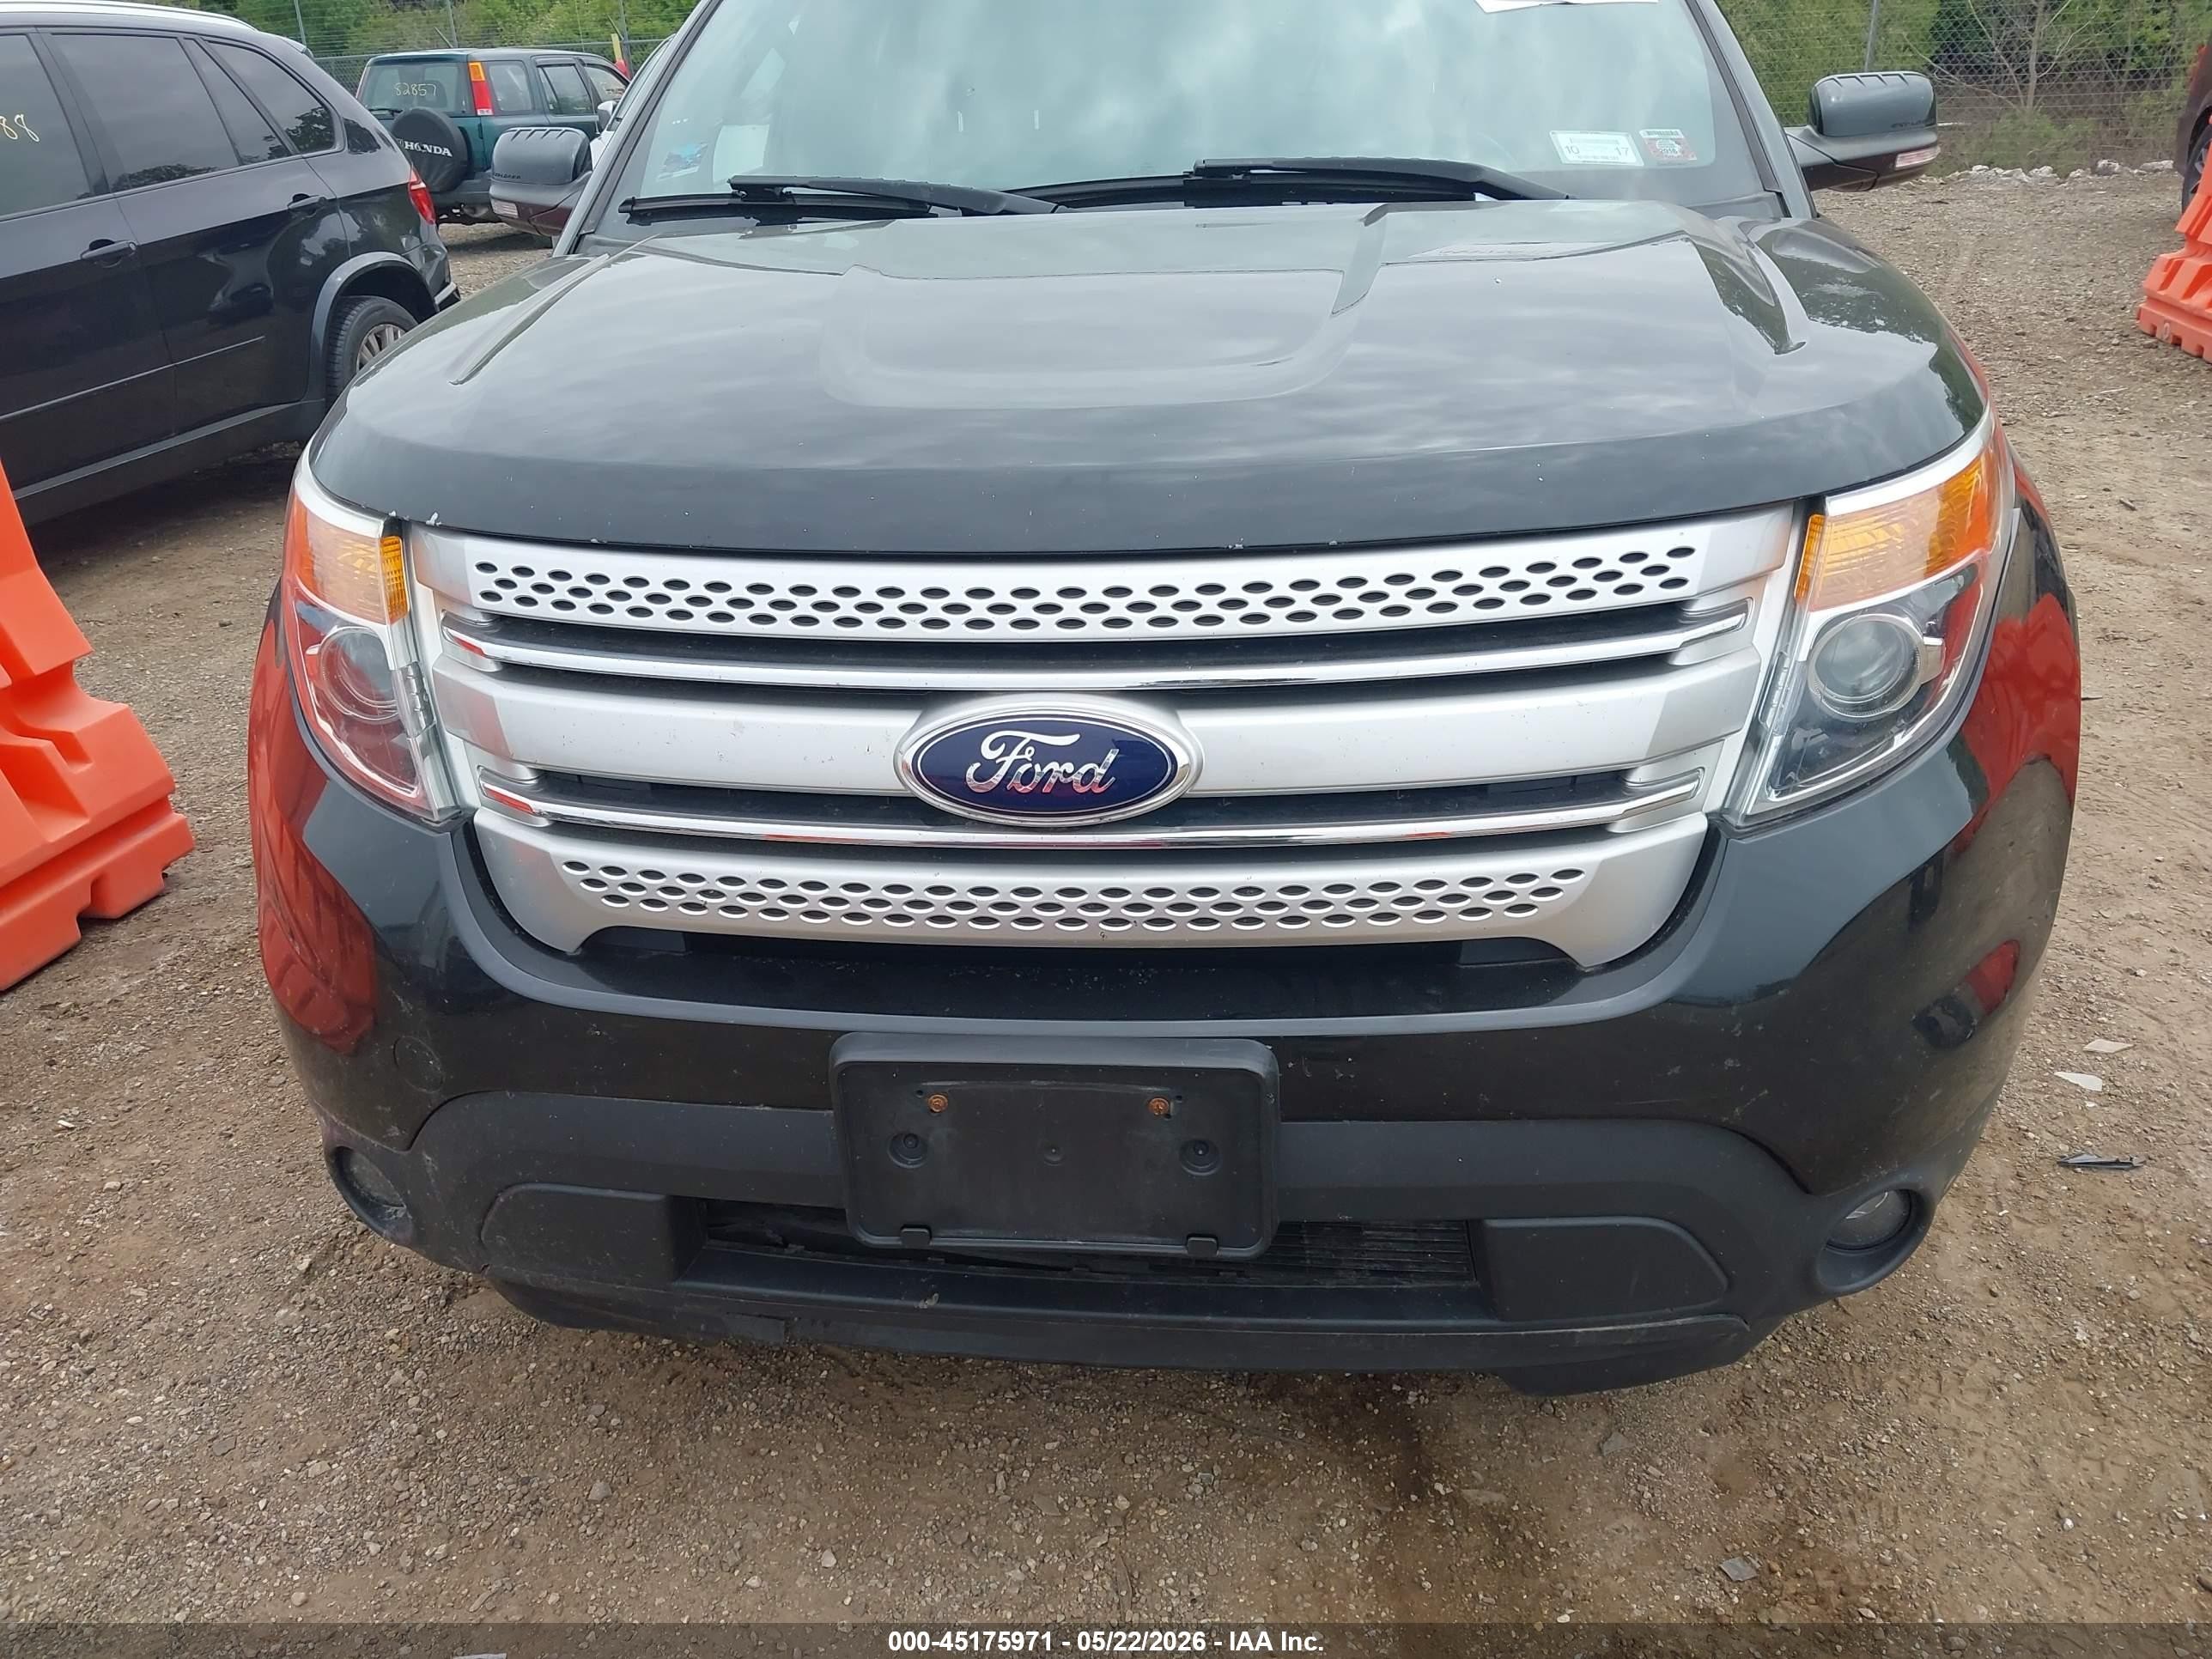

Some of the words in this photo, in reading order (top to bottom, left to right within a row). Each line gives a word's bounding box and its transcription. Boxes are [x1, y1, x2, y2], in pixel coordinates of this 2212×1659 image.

[394, 82, 436, 97] 82857
[404, 140, 453, 158] HONDA
[1564, 145, 1580, 155] 10
[1614, 146, 1629, 156] 17
[966, 730, 1119, 793] Ford
